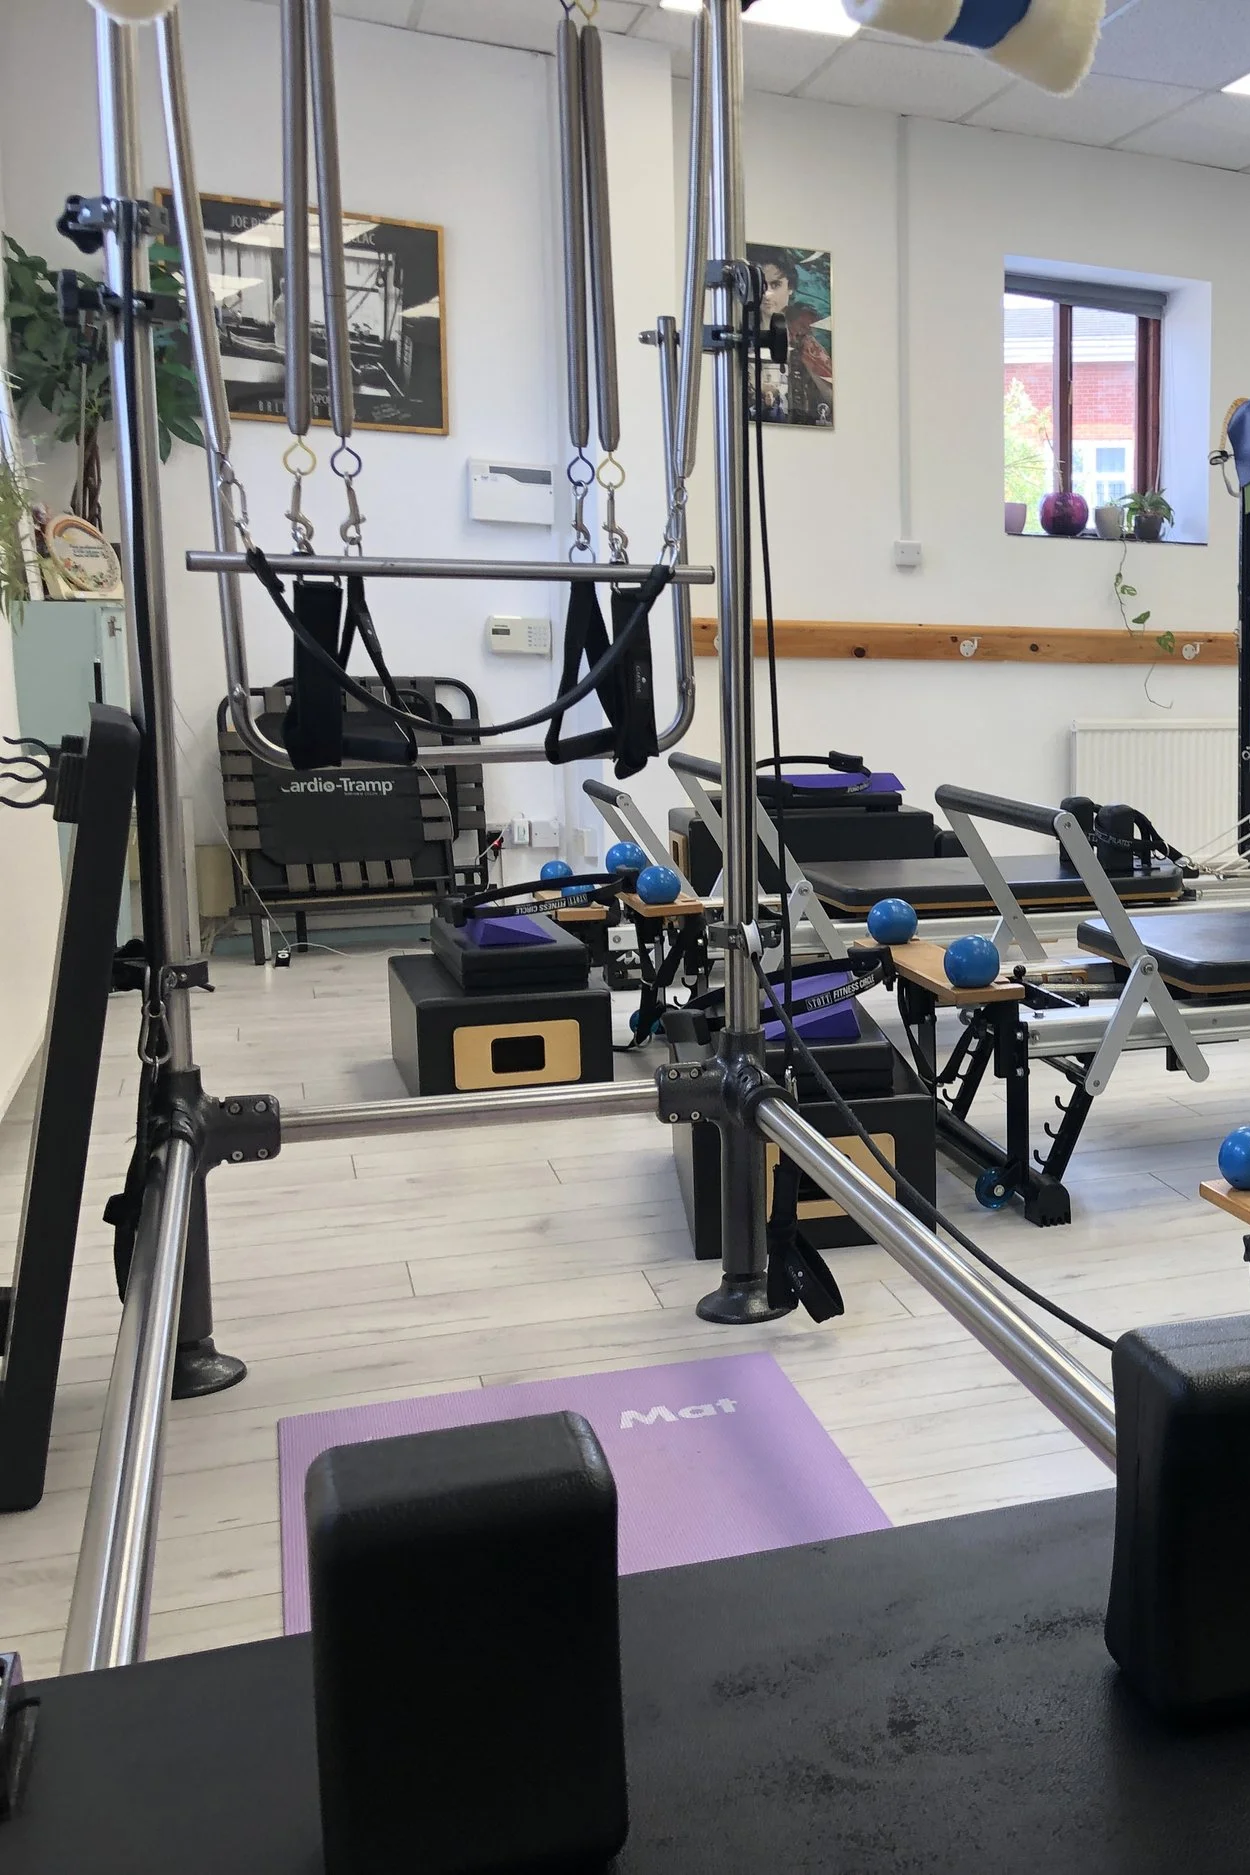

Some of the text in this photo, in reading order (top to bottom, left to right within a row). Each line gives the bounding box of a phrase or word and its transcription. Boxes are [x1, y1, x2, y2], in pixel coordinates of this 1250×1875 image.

[230, 214, 249, 229] JOE
[515, 904, 538, 915] CIRCLE
[539, 900, 567, 912] FITNESS
[833, 982, 860, 999] FITNESS
[860, 974, 876, 989] CIRCLE
[620, 1398, 738, 1429] Mat
